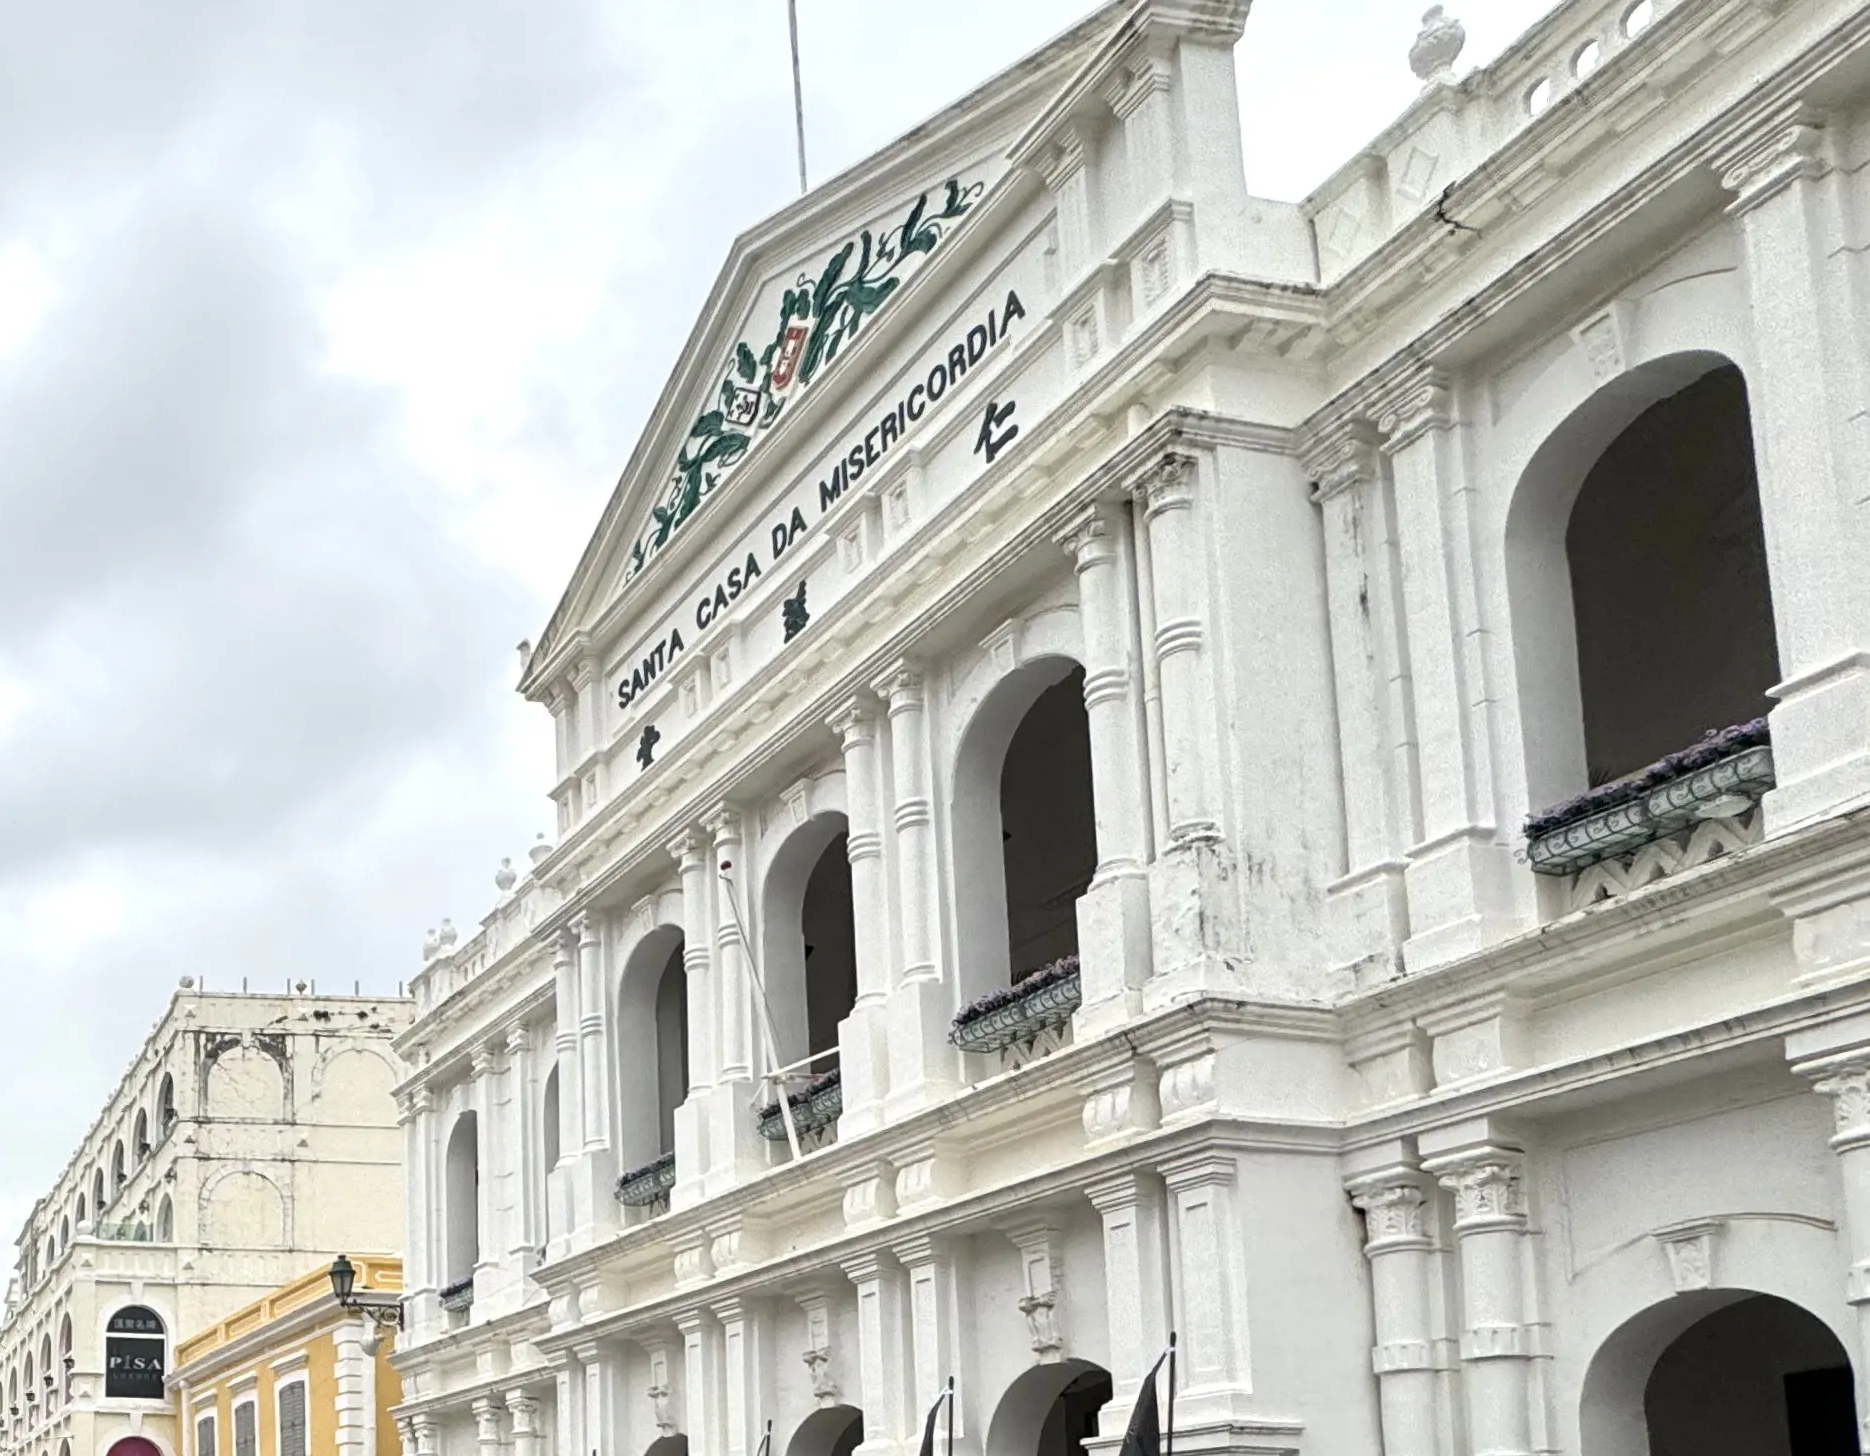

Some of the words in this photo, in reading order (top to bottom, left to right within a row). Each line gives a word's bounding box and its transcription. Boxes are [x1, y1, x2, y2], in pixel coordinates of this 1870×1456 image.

[617, 628, 685, 709] SANTA
[696, 552, 762, 631] CASA
[771, 506, 808, 561] DA
[819, 289, 1026, 513] MISERICORDIA
[109, 1354, 162, 1370] PISA
